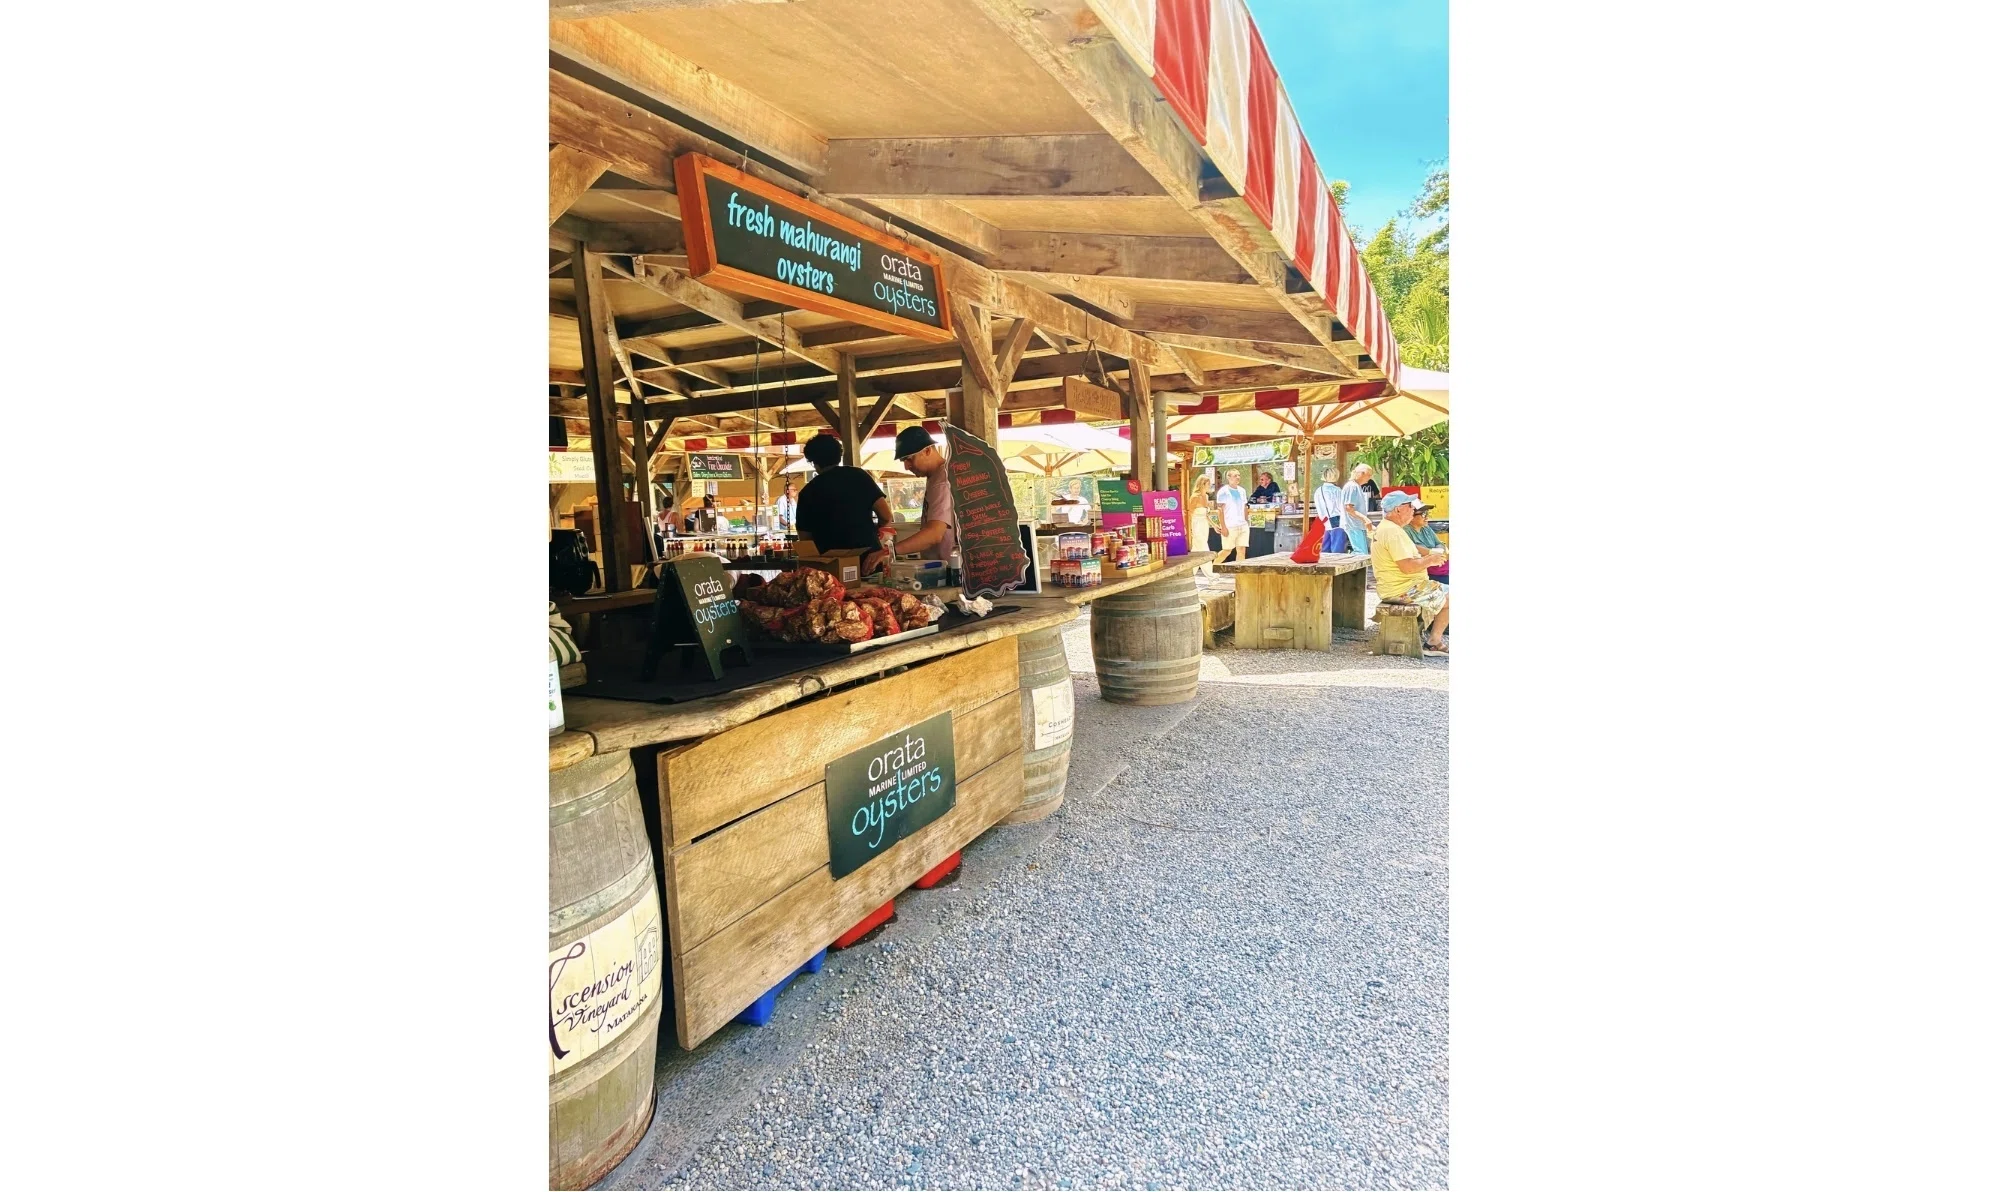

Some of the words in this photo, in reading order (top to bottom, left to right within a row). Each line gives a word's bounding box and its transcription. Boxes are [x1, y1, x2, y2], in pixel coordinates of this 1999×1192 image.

[727, 191, 775, 238] fresh
[780, 219, 861, 272] mahurangi
[777, 257, 834, 294] oysters
[881, 254, 922, 281] orata
[883, 272, 903, 285] MARINE
[905, 279, 924, 292] LIMITED
[873, 278, 936, 317] oysters
[694, 576, 724, 597] orata
[695, 595, 738, 634] oysters
[868, 734, 926, 782] orata
[868, 775, 897, 798] MARINE
[901, 761, 927, 780] LIMITED
[852, 767, 942, 849] oysters
[563, 974, 632, 1033] Vineyard
[606, 994, 648, 1033] MATAKANA
